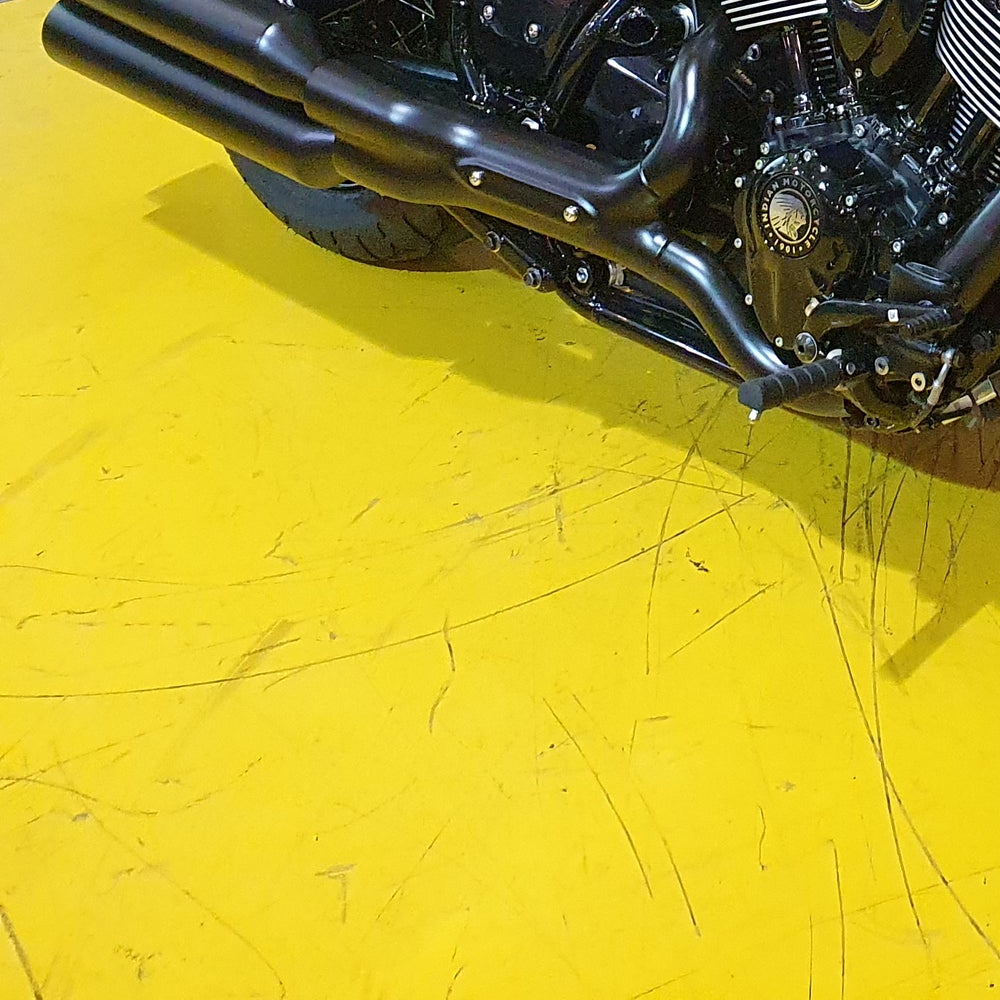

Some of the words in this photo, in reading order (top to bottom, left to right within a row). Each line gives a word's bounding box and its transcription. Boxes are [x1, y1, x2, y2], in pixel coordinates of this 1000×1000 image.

[761, 181, 780, 229] INDIAN
[782, 177, 820, 249] MOTORCYCLE
[774, 238, 797, 255] 1901
